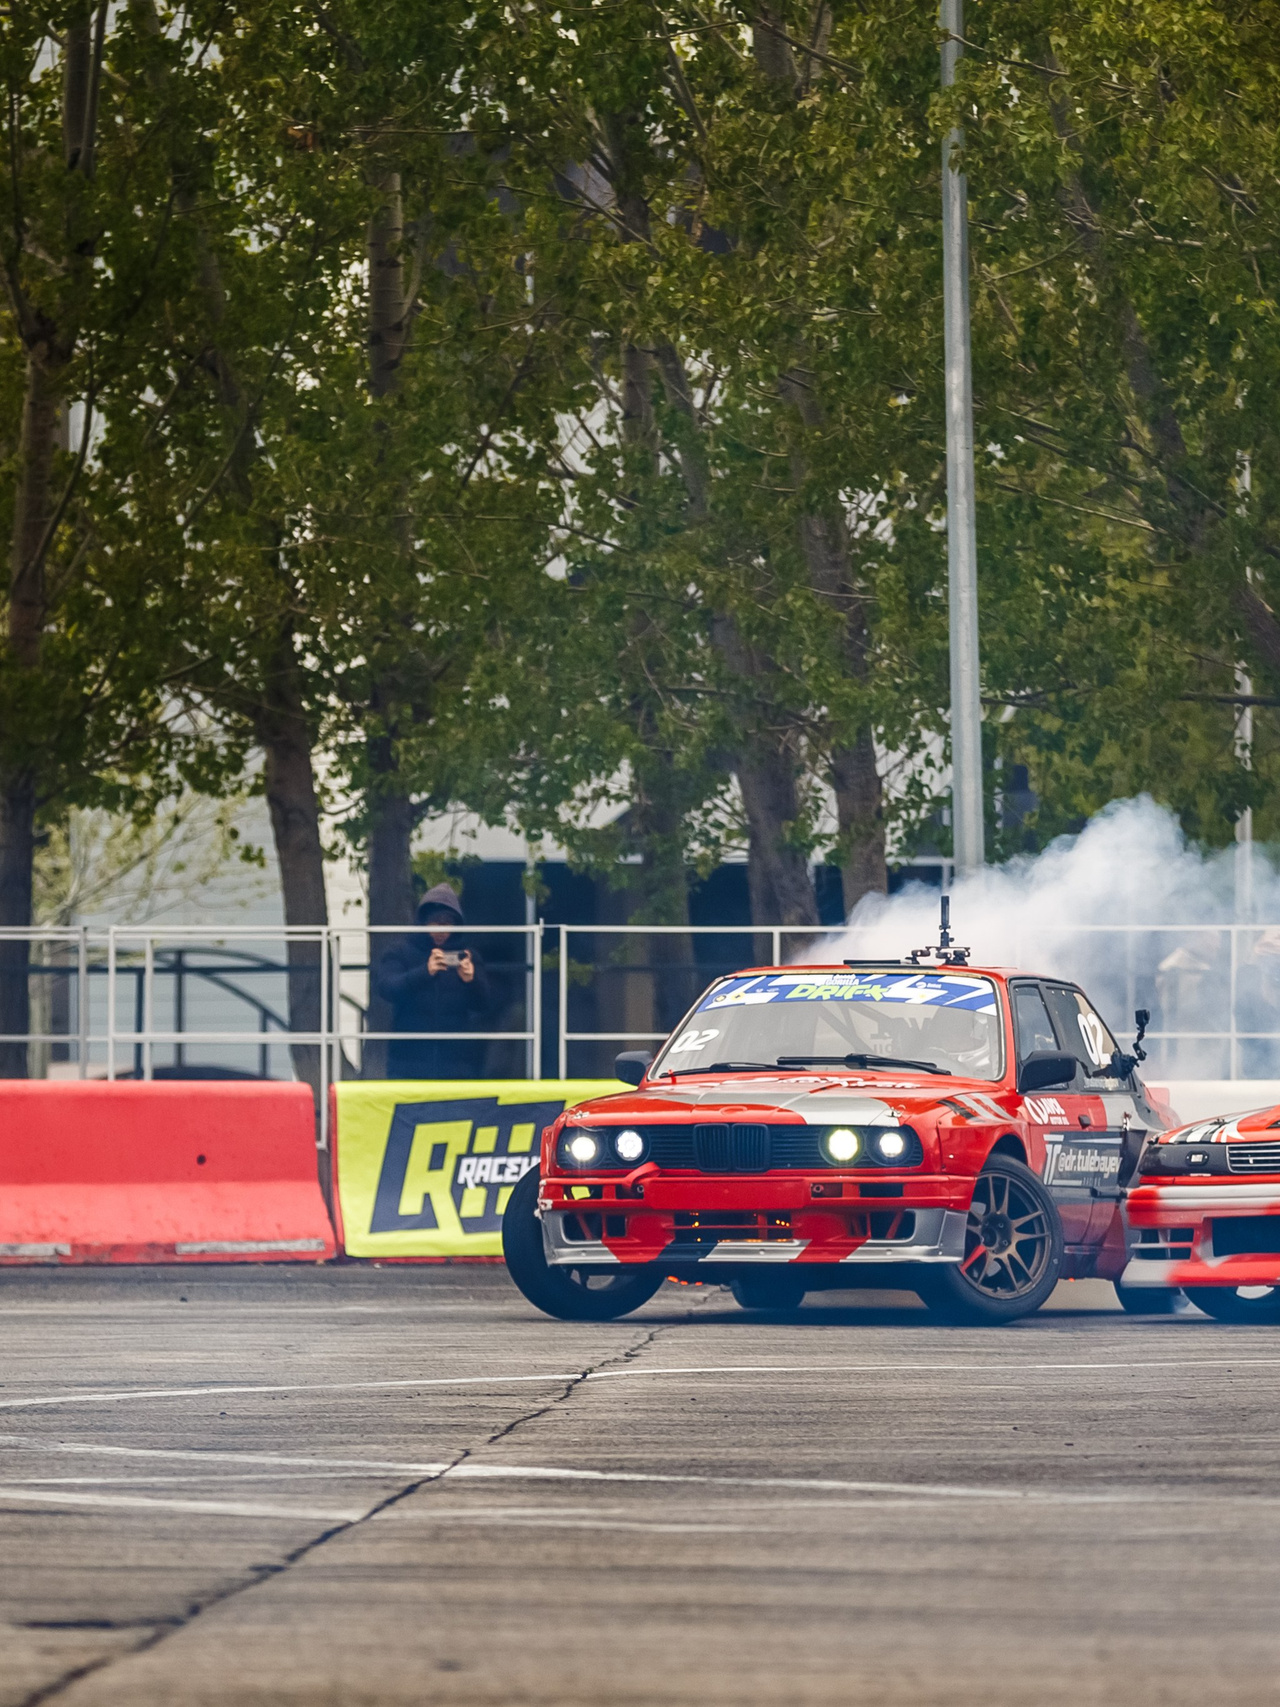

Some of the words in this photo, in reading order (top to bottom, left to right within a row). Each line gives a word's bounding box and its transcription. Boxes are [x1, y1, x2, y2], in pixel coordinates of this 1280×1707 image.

[785, 984, 889, 1001] DRIFT
[670, 1029, 720, 1053] 02
[1077, 1013, 1112, 1066] 02
[1057, 1148, 1123, 1179] @dr.tulebayev
